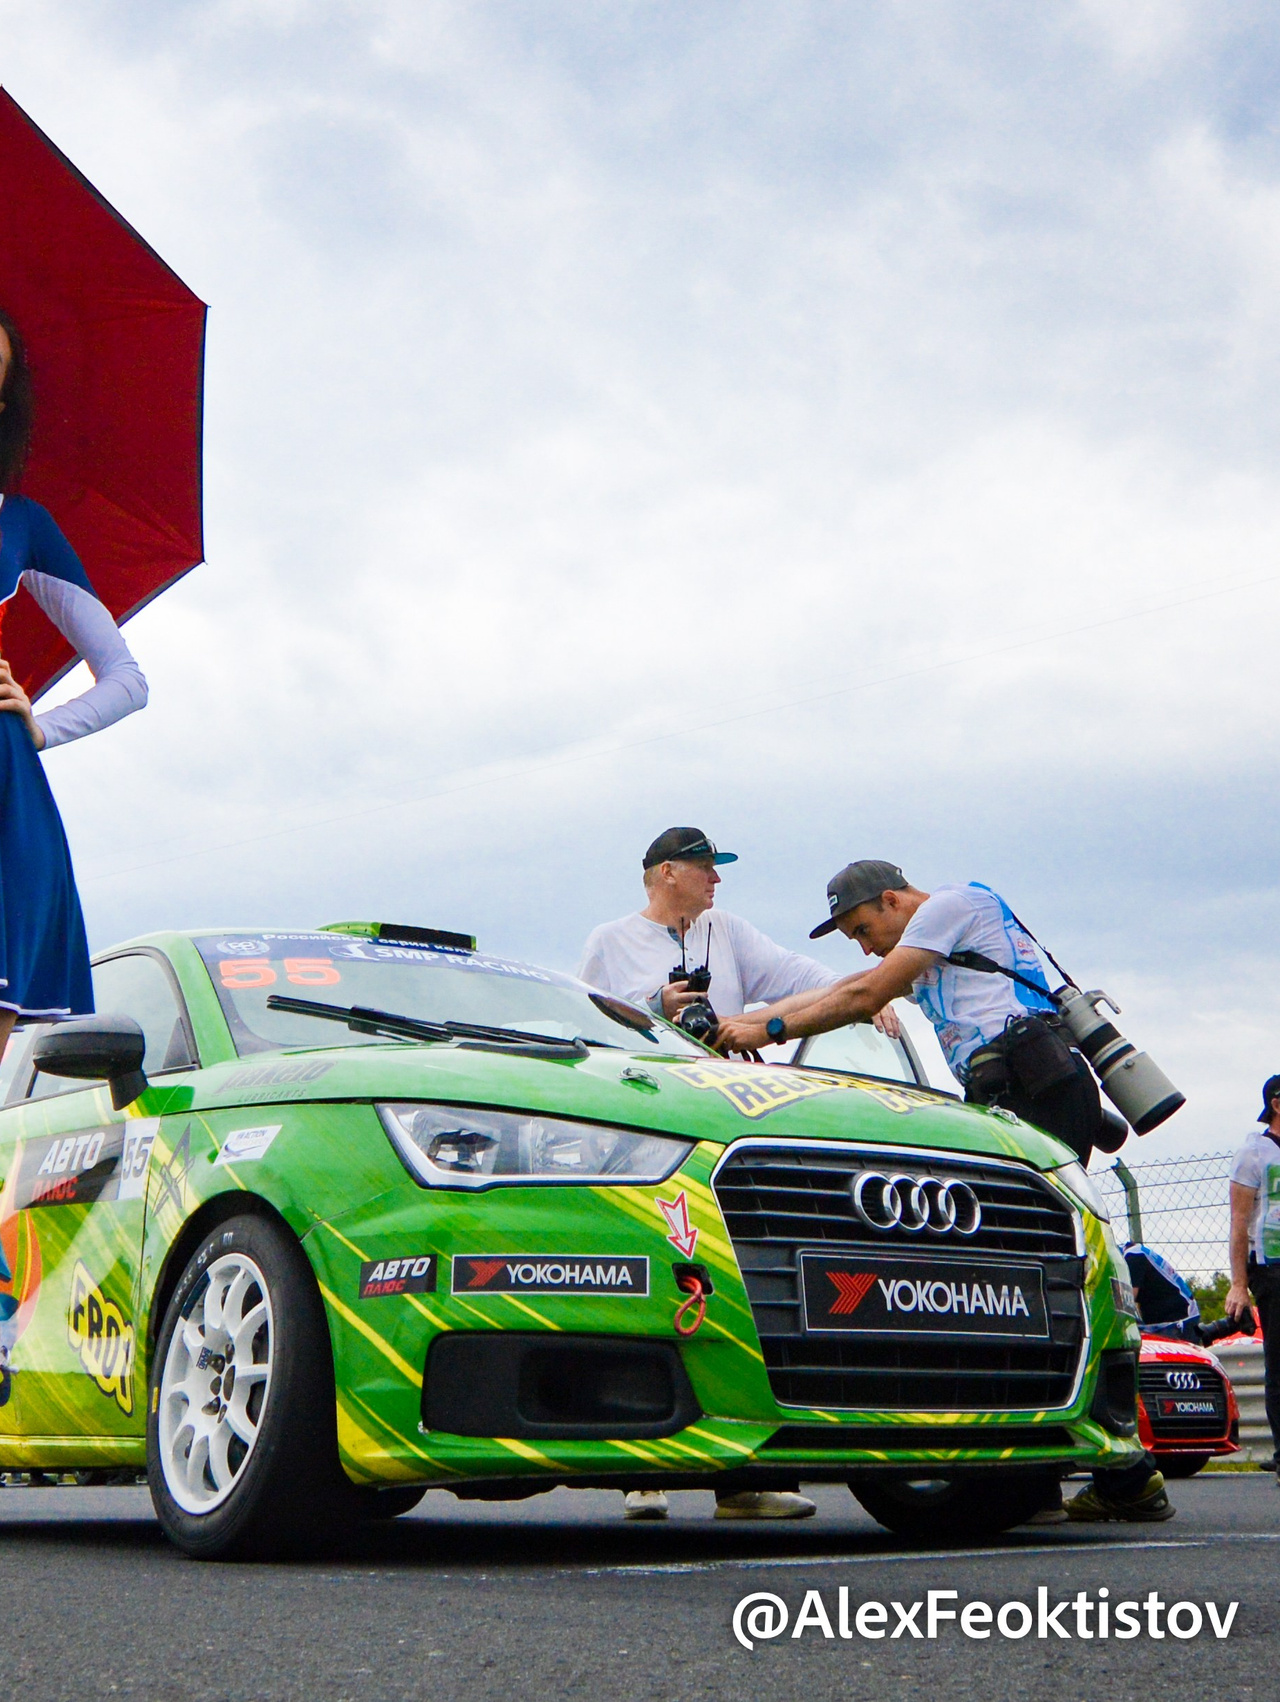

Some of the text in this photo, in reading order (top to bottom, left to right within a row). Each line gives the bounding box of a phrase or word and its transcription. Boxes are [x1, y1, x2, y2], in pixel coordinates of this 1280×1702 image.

[219, 957, 341, 989] 55
[374, 948, 439, 961] SMP
[445, 954, 551, 981] RACING
[37, 1132, 106, 1176] АВТО
[122, 1136, 154, 1180] 55
[368, 1257, 431, 1282] АВТО
[506, 1263, 634, 1286] YOKOHAMA
[363, 1279, 407, 1296] ПЛЮС
[877, 1278, 1030, 1317] YOKOHAMA
[1175, 1402, 1214, 1413] YOKOHAMA
